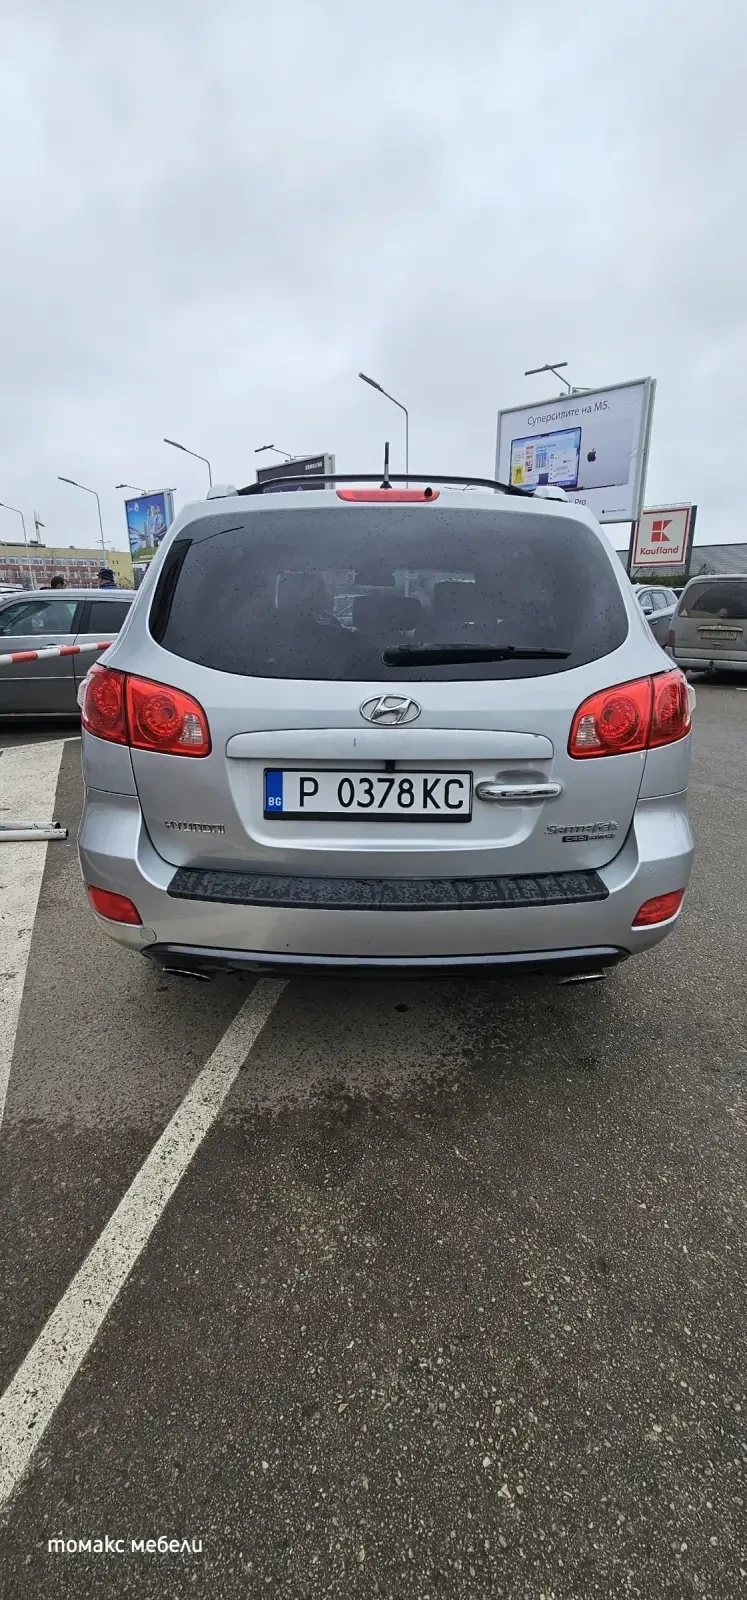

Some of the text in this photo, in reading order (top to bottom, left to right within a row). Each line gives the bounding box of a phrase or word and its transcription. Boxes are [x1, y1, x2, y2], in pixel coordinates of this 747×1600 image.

[527, 400, 611, 427] Суперсилите на M5.
[304, 461, 323, 471] SAMSUNG
[640, 545, 680, 556] Kaufland
[299, 776, 319, 807] P
[268, 796, 282, 807] BG
[164, 819, 225, 834] HYUNDAI
